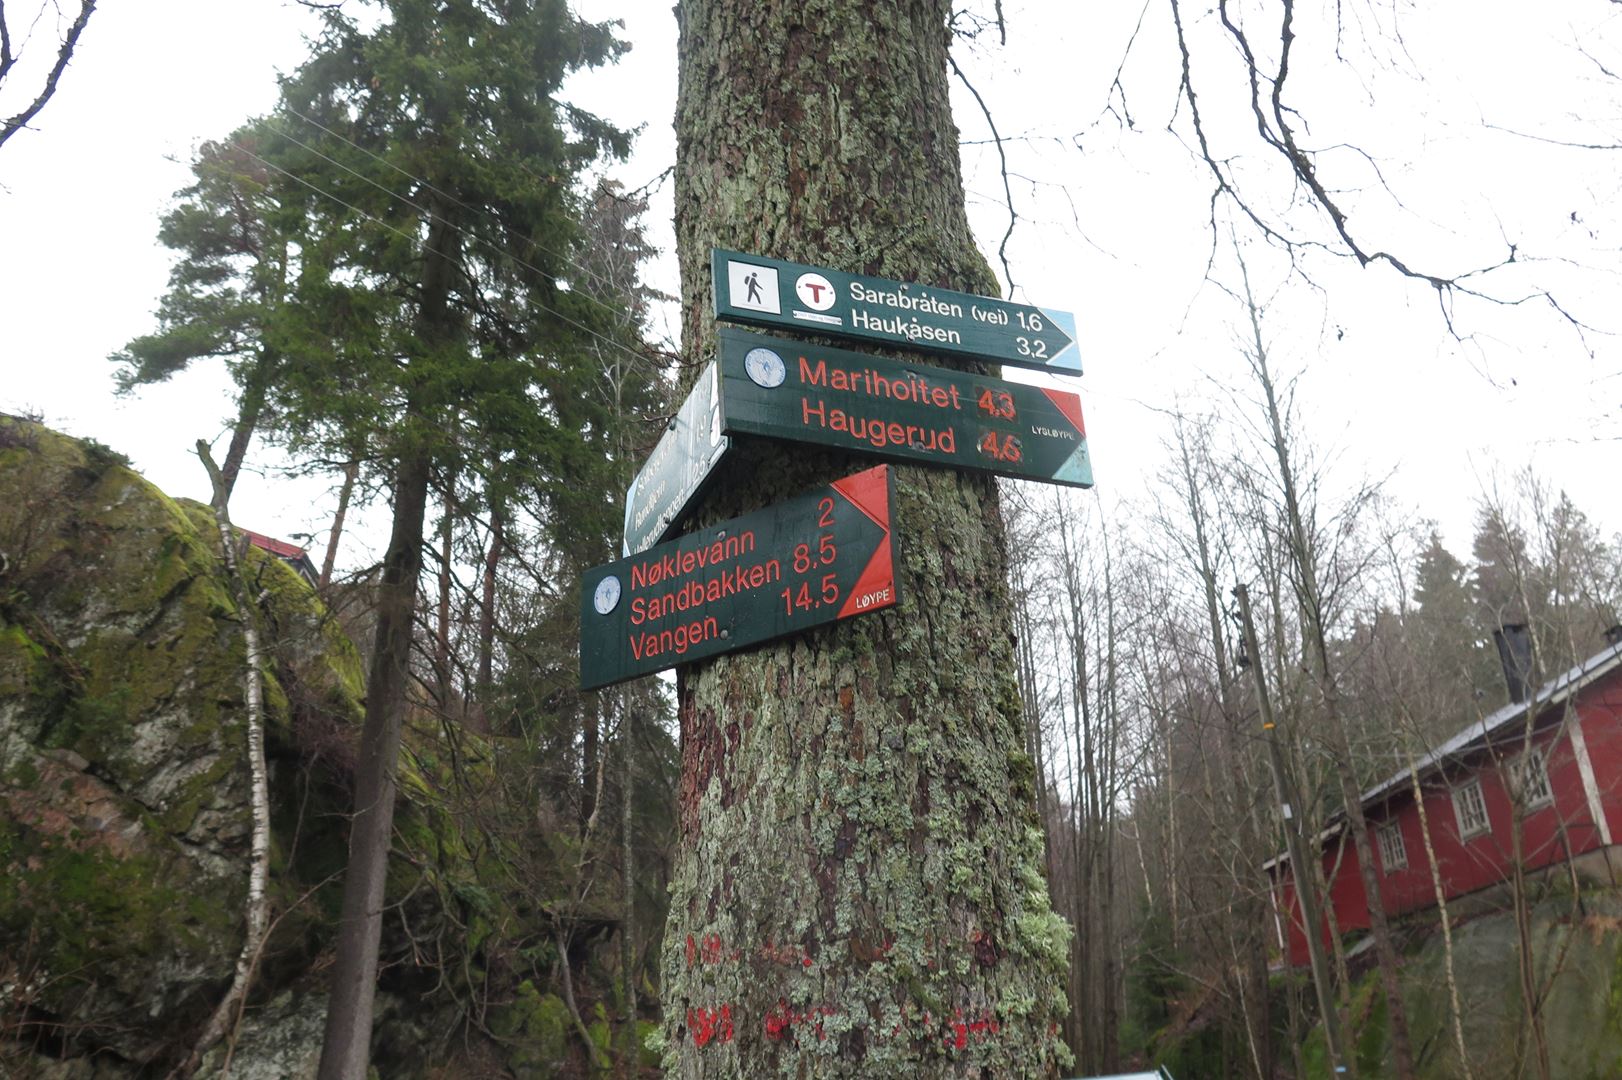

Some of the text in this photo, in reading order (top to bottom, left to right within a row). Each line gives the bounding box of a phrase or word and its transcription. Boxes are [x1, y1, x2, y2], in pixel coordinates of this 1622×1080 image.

[850, 282, 962, 318] Sarabråten
[972, 305, 1008, 326] (vei)
[1016, 311, 1043, 332] 1,6
[852, 308, 961, 344] Haukåsen
[1016, 336, 1048, 358] 3,2
[799, 356, 961, 410] Mariholtet
[802, 397, 956, 453] Haugerud
[631, 496, 836, 591] Nøklevann 2
[631, 559, 780, 625] Sandbakken
[793, 535, 836, 574] 8,5
[856, 589, 890, 609] LØYPE
[629, 573, 839, 660] Vangen 14,5
